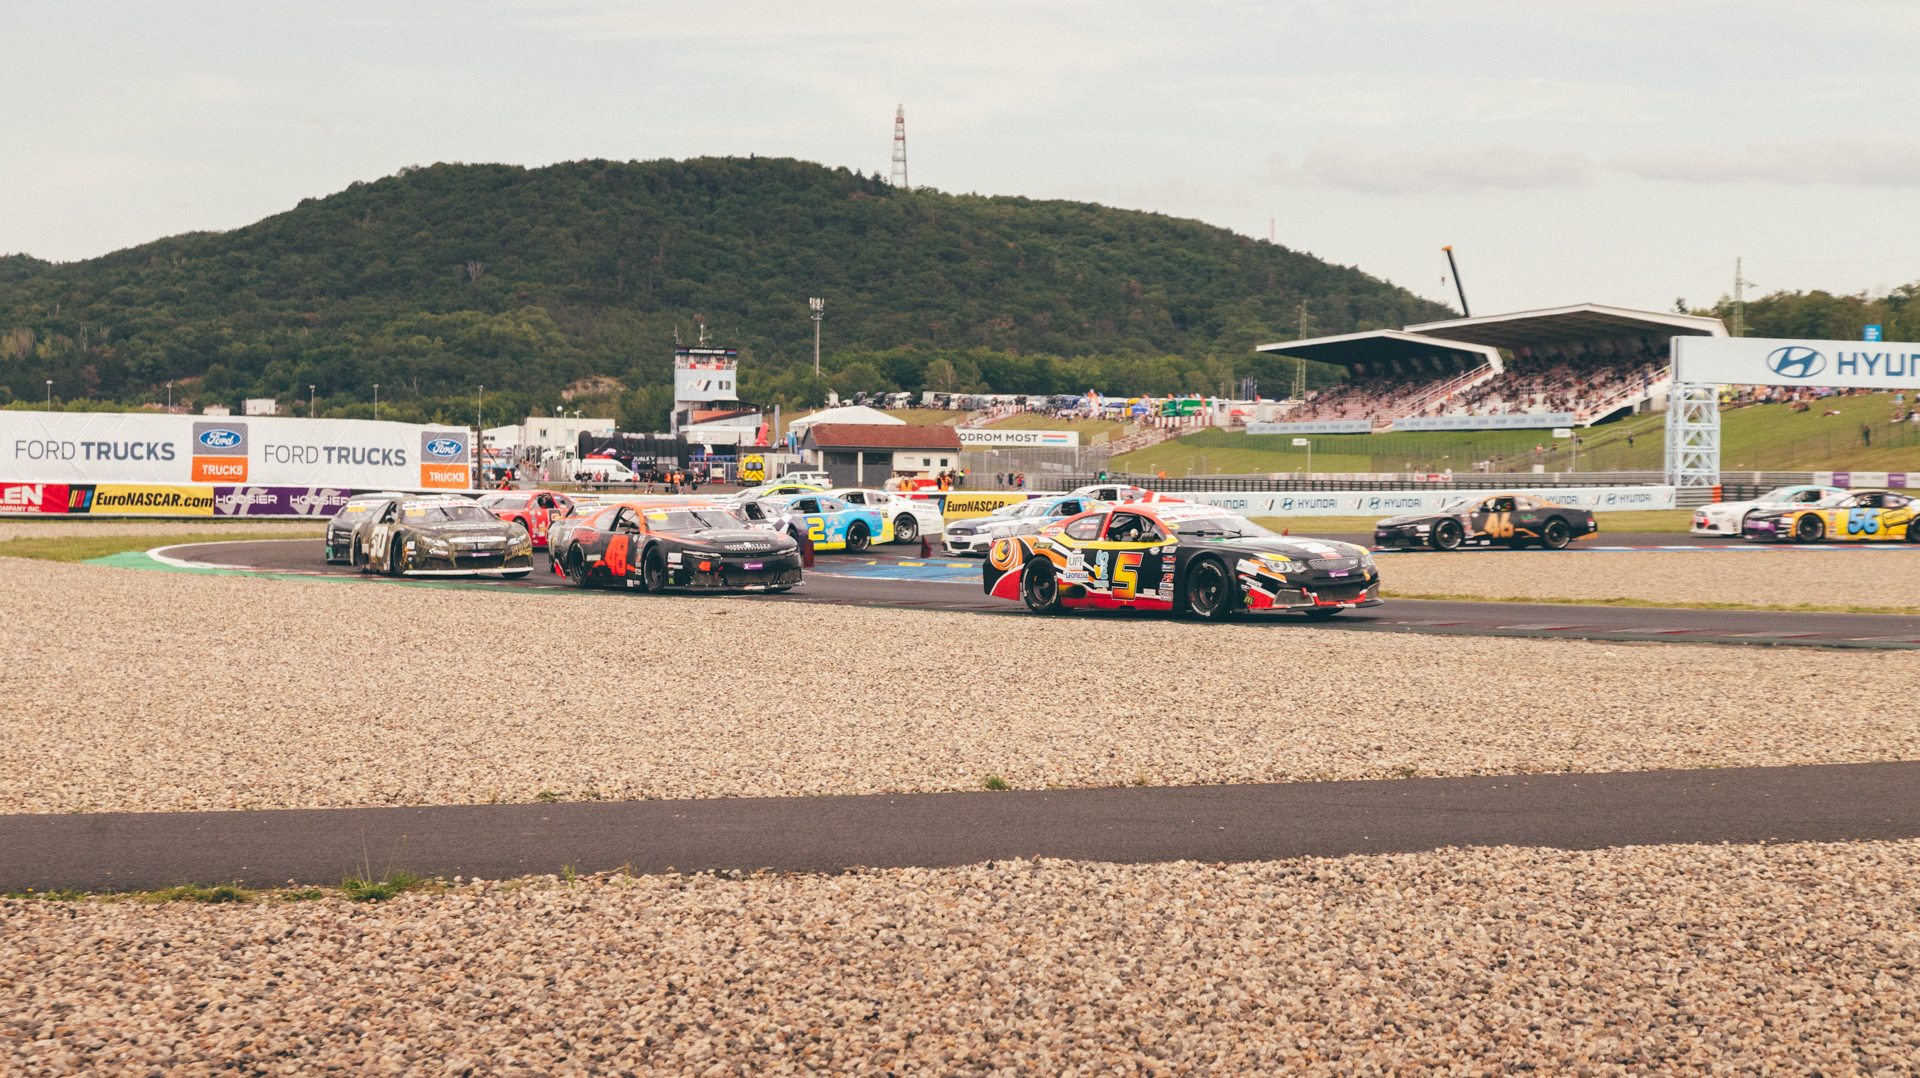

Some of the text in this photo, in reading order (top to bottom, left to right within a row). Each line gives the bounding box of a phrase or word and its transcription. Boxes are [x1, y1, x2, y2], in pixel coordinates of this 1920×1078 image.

[207, 432, 234, 446] Ford
[959, 433, 1038, 442] ODROM MOST
[15, 440, 175, 461] FORD TRUCKS
[264, 445, 406, 466] FORD TRUCKS
[433, 443, 458, 456] Ford
[202, 465, 243, 476] TRUCKS
[429, 473, 464, 483] TRUCKS
[96, 493, 213, 508] EuroNASCAR.com
[216, 495, 278, 505] HOOSIER
[1297, 499, 1338, 509] HYUNDAI
[1384, 498, 1422, 508] HYUNDAI
[1620, 494, 1653, 504] HYUNDAI
[406, 509, 427, 517] 50
[1484, 513, 1515, 538] 46
[1847, 508, 1880, 535] 56
[807, 517, 826, 541] 2
[371, 526, 389, 558] 50
[604, 534, 629, 576] 48
[698, 561, 711, 572] 48
[1112, 551, 1145, 602] 5
